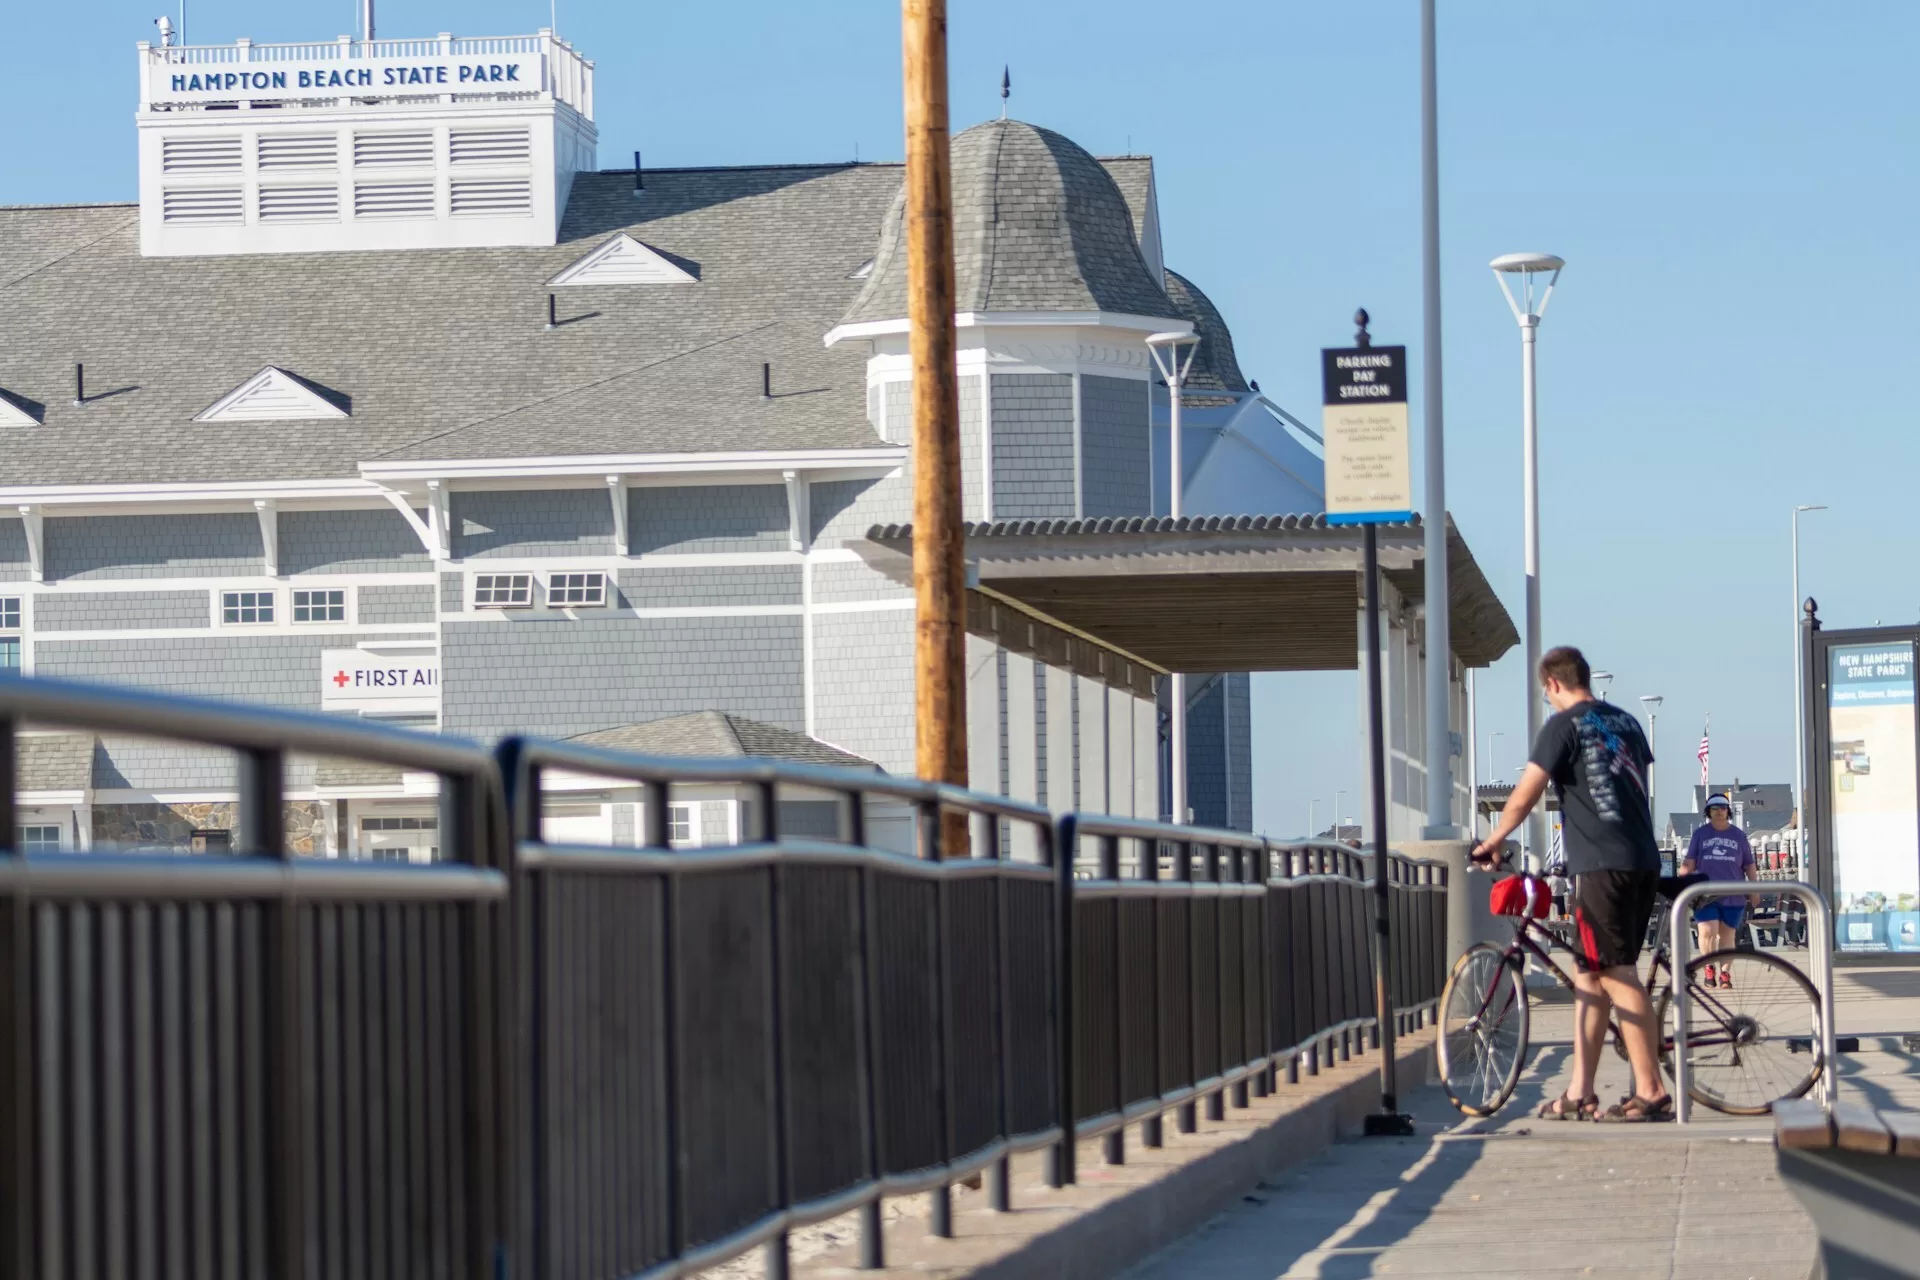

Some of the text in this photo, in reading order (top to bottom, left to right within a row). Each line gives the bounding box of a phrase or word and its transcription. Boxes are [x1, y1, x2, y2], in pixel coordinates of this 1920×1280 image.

[172, 63, 520, 92] HAMPTON BEACH STATE PARK
[1336, 355, 1392, 368] PARKING
[1353, 370, 1376, 382] PAY
[1340, 384, 1390, 398] STATION
[1839, 652, 1913, 666] NEW HAMPSHIRE
[355, 668, 438, 687] FIRST AI
[1847, 664, 1906, 678] STATE PARKS
